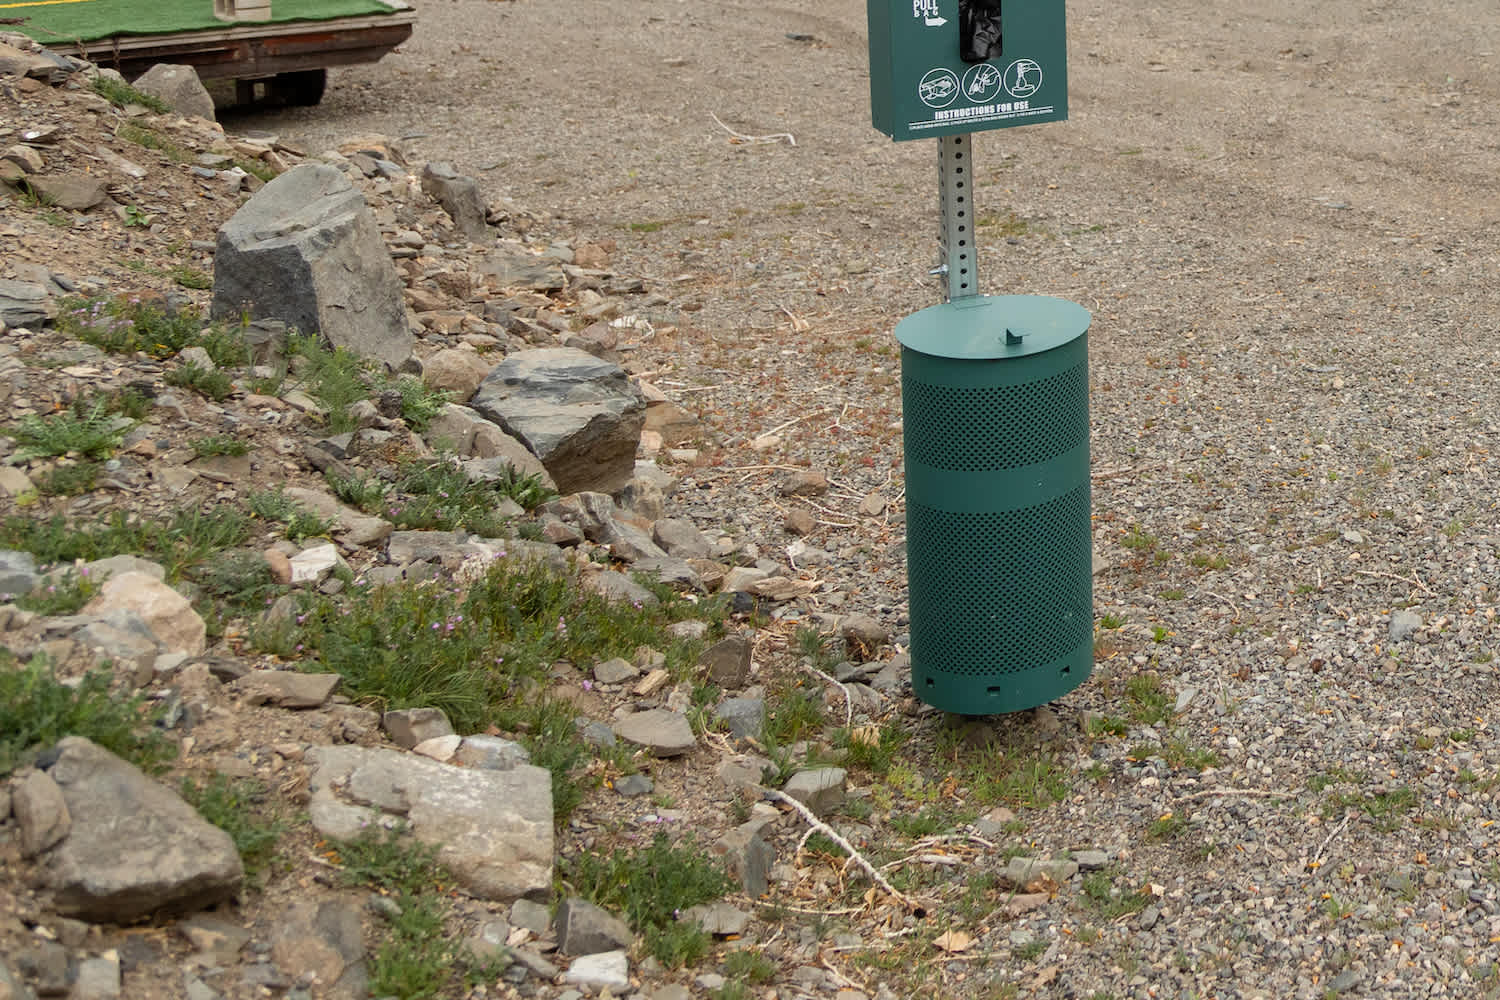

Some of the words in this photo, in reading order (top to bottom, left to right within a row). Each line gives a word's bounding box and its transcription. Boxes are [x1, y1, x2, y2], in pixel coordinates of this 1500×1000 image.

[934, 104, 995, 120] INSTRUCTIONS
[997, 103, 1012, 113] FOR
[1014, 101, 1029, 110] USE
